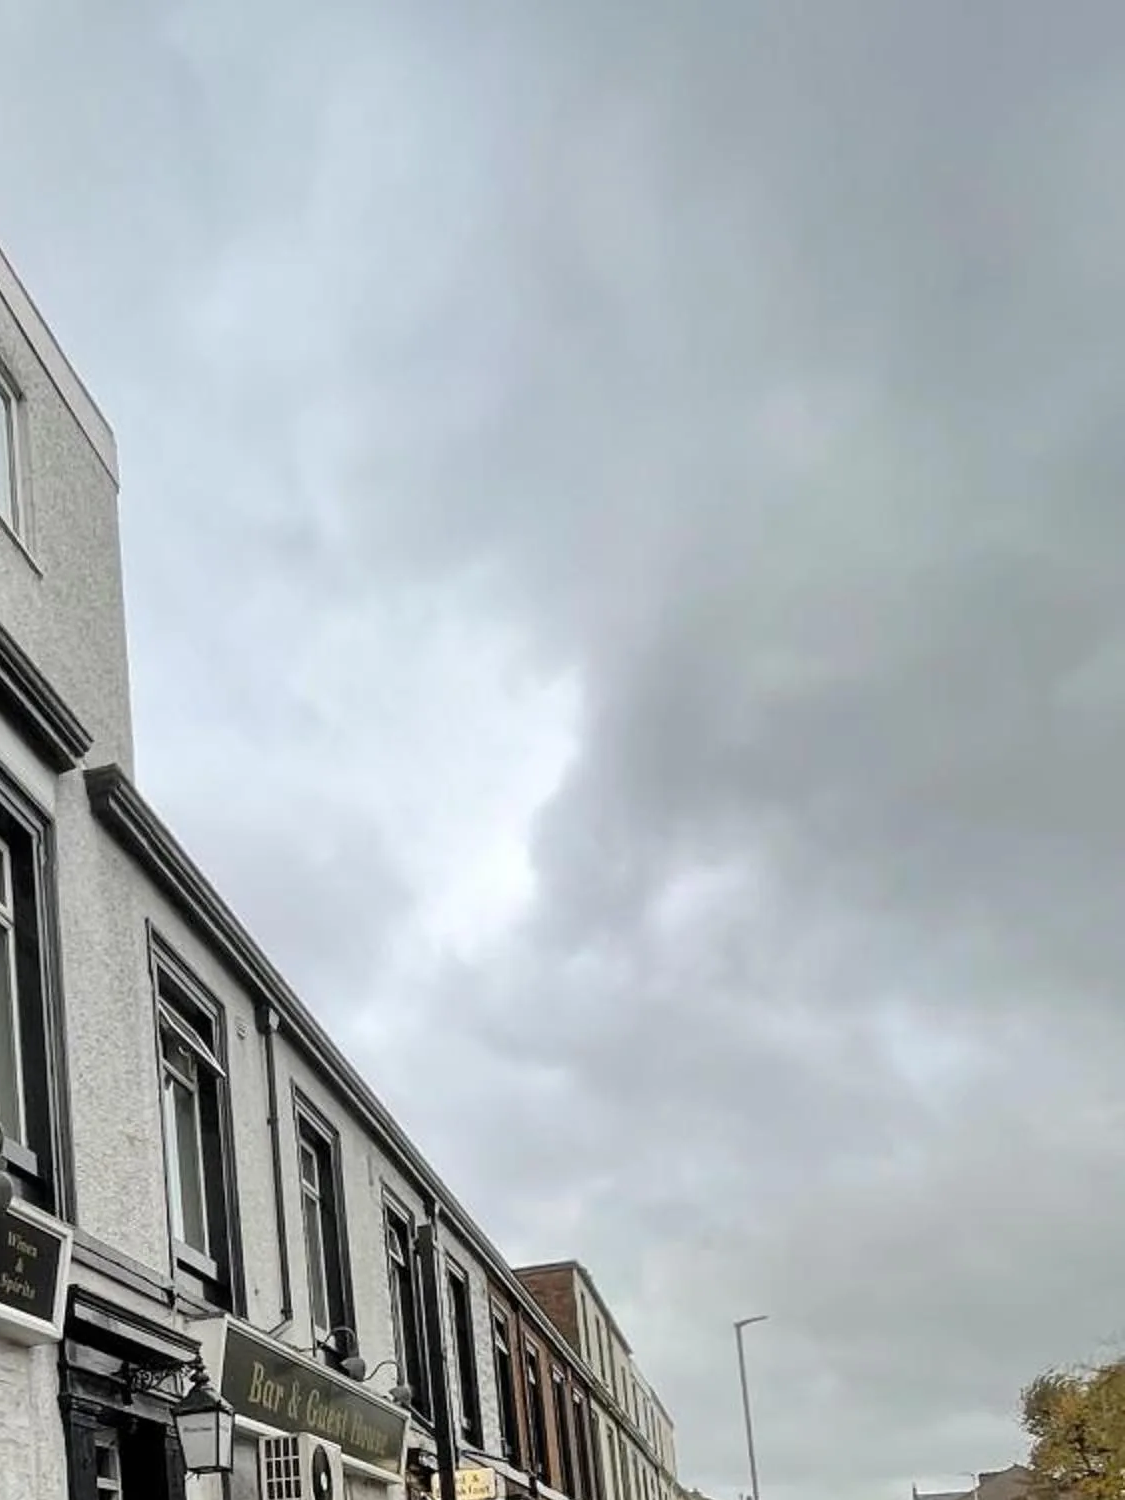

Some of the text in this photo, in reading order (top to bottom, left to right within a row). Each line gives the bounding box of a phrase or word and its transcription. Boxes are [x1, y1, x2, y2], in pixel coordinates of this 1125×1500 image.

[248, 1360, 285, 1413] Bar
[288, 1379, 302, 1420] &
[307, 1388, 349, 1439] Guest
